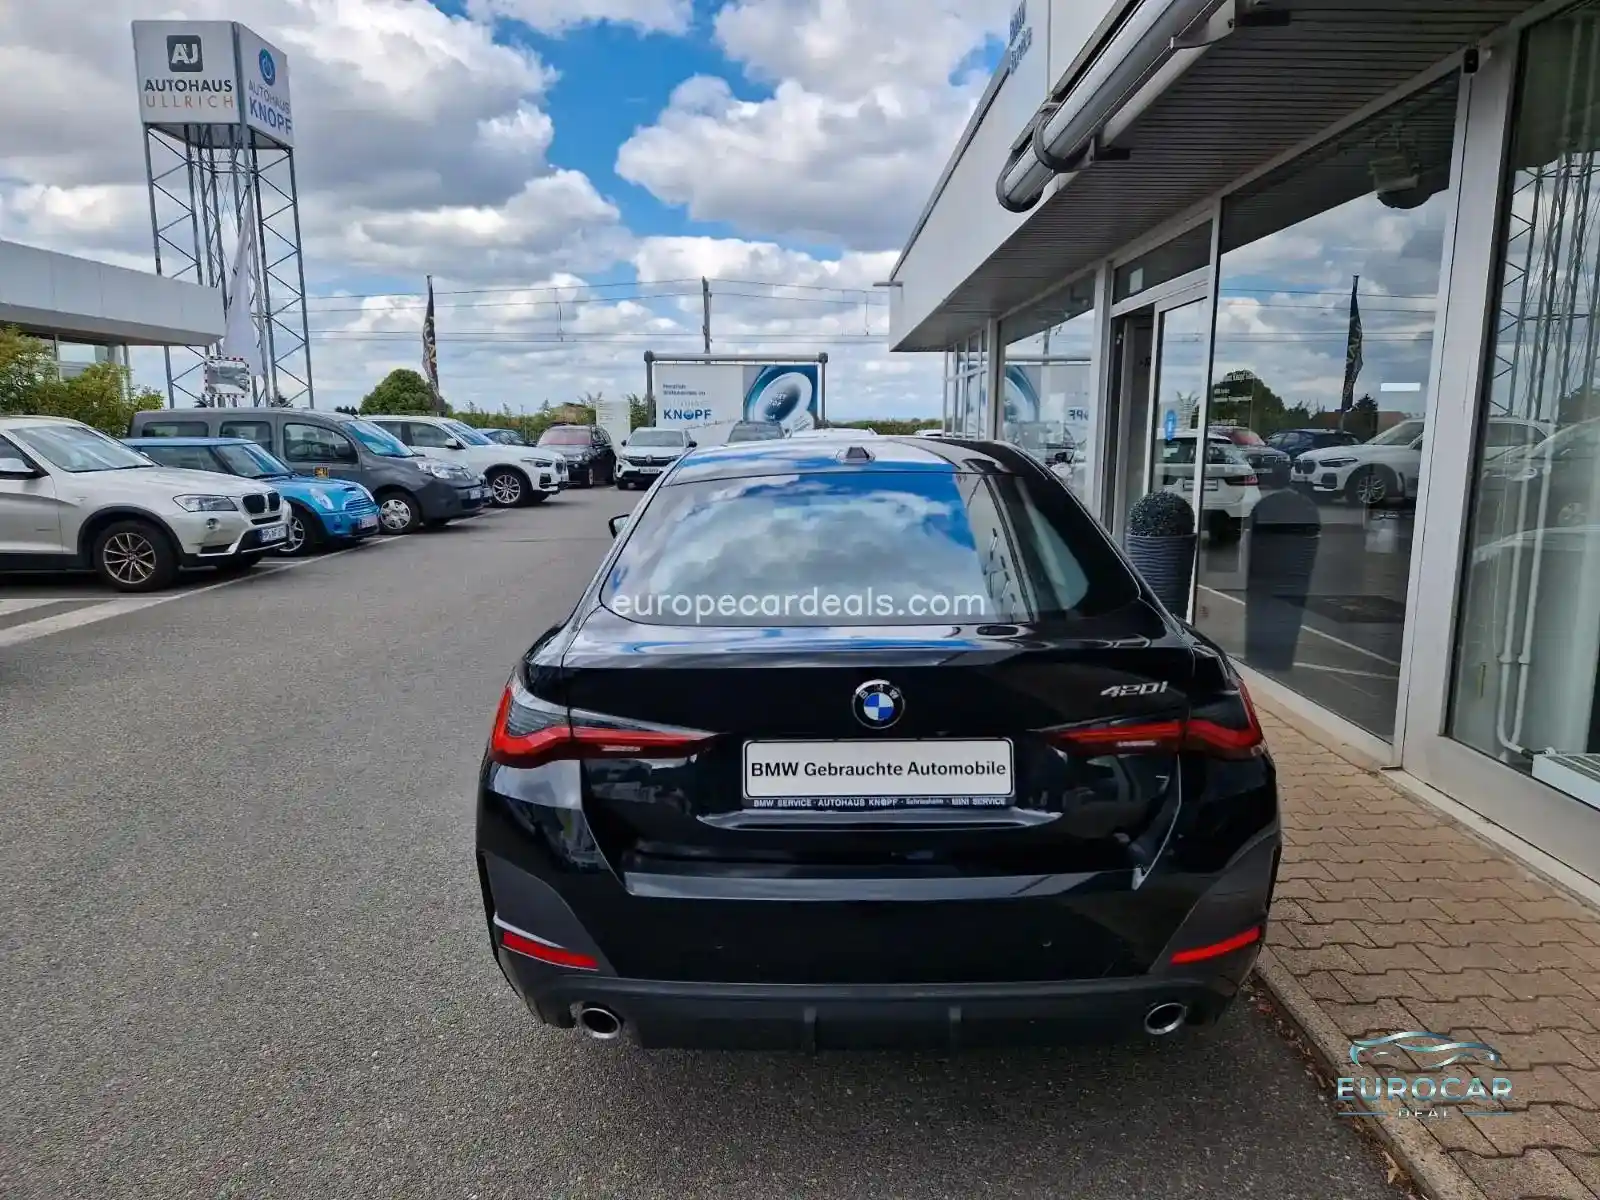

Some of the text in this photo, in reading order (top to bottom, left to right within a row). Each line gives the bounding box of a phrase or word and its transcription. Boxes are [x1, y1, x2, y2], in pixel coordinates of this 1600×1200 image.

[144, 79, 233, 92] AUTOHAUS
[146, 95, 234, 108] ULLRICH
[249, 79, 290, 114] AUTOHAUS
[249, 96, 292, 134] KNOPF
[663, 409, 712, 420] KNOPF
[751, 760, 1006, 777] BMW Gebrauchte Automobile
[753, 799, 774, 808] BMW
[777, 799, 812, 808] SERVICE
[817, 798, 865, 808] AUTOHAUS
[868, 798, 898, 807] KNOPF
[972, 797, 1006, 806] SERVICE
